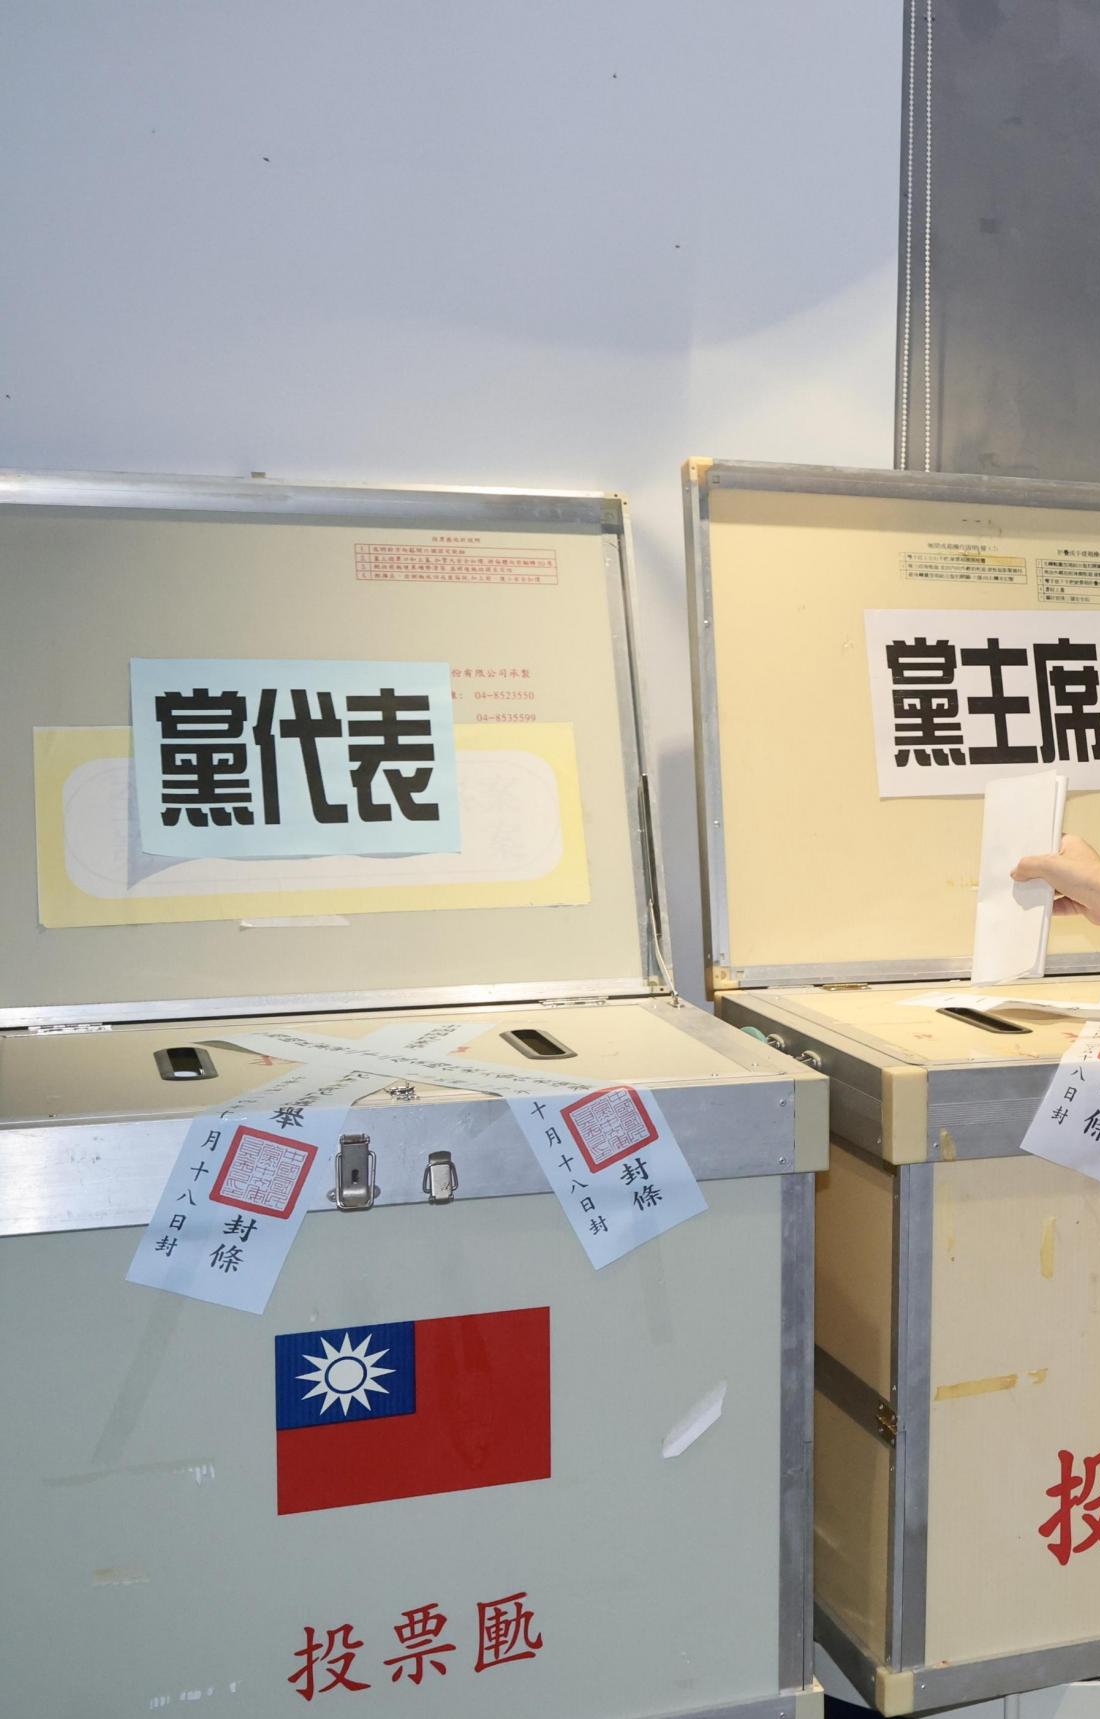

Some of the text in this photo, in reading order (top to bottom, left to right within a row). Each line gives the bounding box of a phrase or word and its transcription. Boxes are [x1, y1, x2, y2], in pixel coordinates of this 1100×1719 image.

[155, 688, 440, 826] 黨代表
[530, 1101, 609, 1235] 十月十八日封
[620, 1157, 662, 1211] 封條
[209, 1214, 258, 1273] 封條
[288, 1592, 544, 1701] 投票匭
